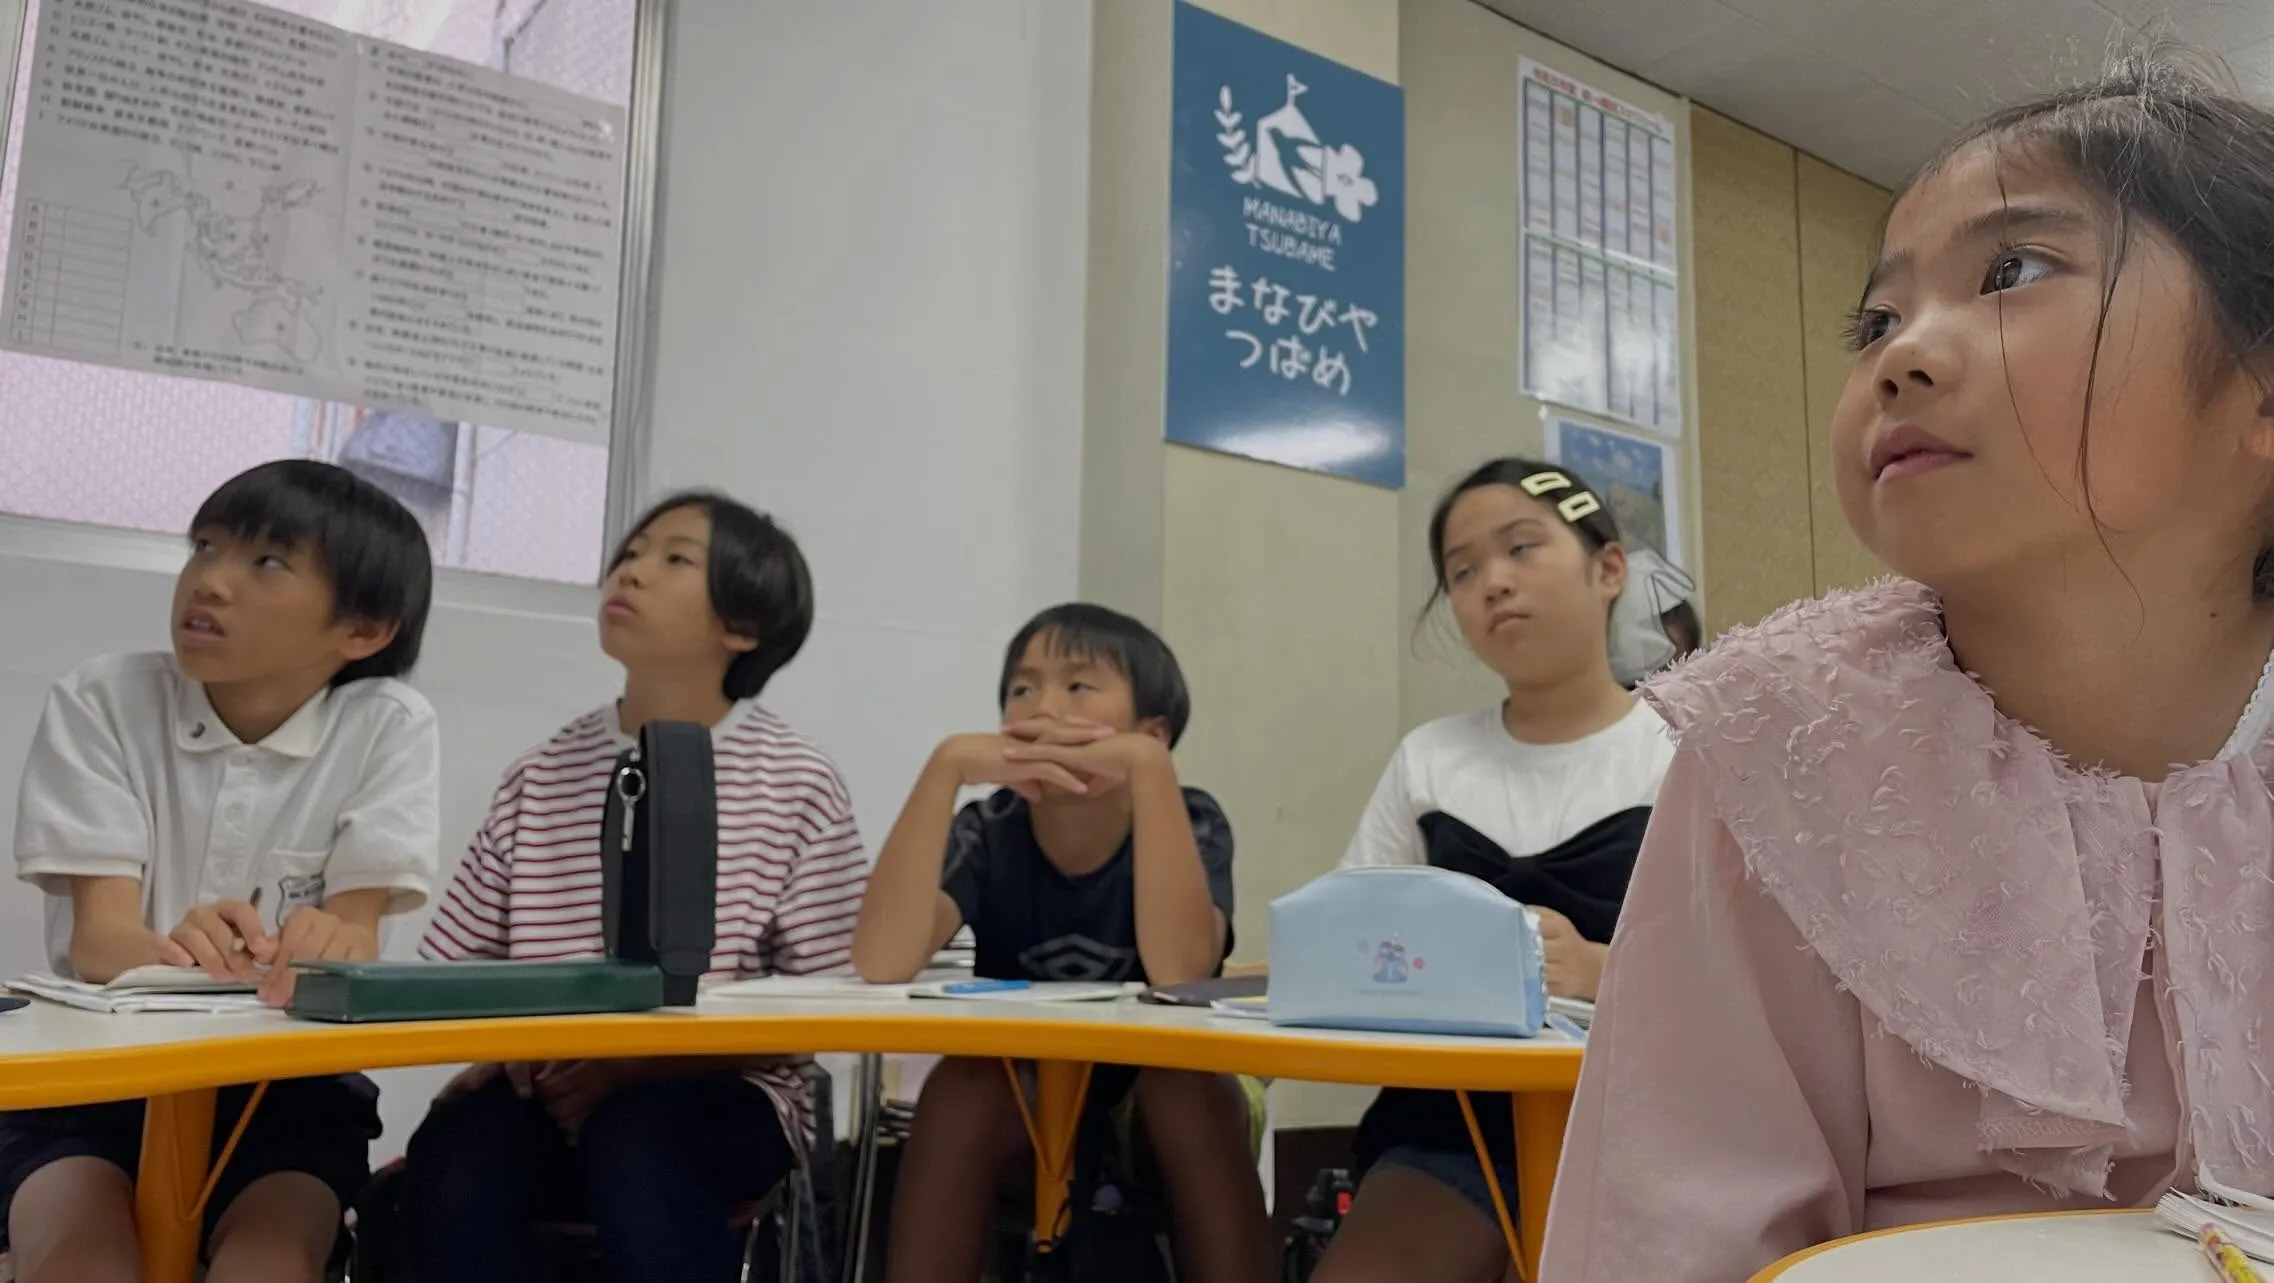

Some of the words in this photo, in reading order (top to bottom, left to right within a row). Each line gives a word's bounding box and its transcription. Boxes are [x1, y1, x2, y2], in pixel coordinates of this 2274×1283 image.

[1243, 197, 1342, 246] MANABIYA
[1246, 224, 1336, 271] TSUBAME
[1208, 265, 1378, 352] まなびや
[1225, 330, 1351, 396] つばめ
